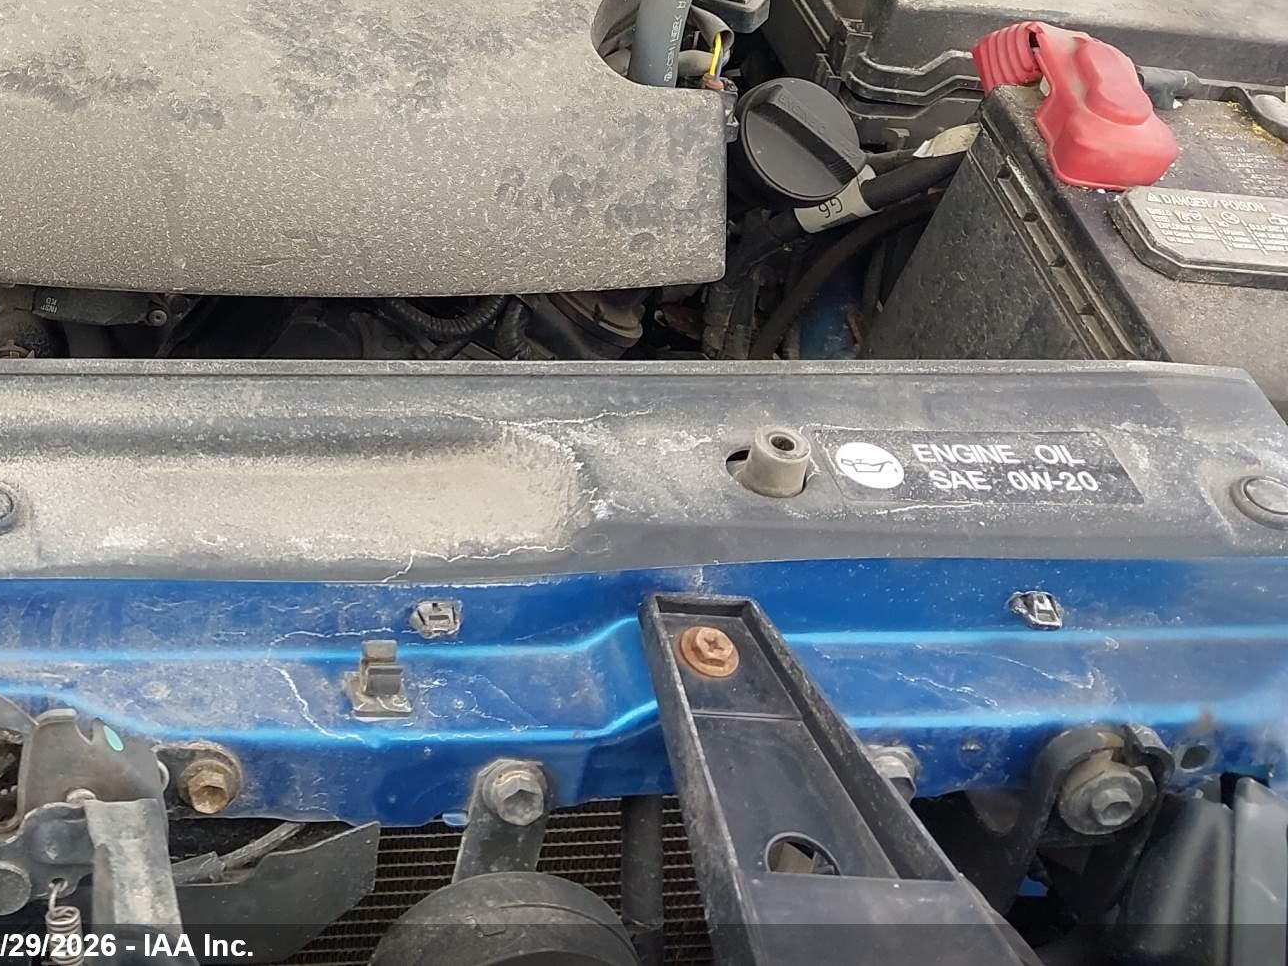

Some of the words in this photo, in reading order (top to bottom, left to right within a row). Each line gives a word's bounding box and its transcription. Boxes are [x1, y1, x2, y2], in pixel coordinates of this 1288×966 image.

[1163, 193, 1209, 209] DANGER
[1222, 199, 1268, 213] POISON
[912, 443, 1020, 465] ENGINE
[1034, 444, 1086, 466] OIL
[929, 470, 992, 491] SAE
[1008, 470, 1099, 492] 0W-20
